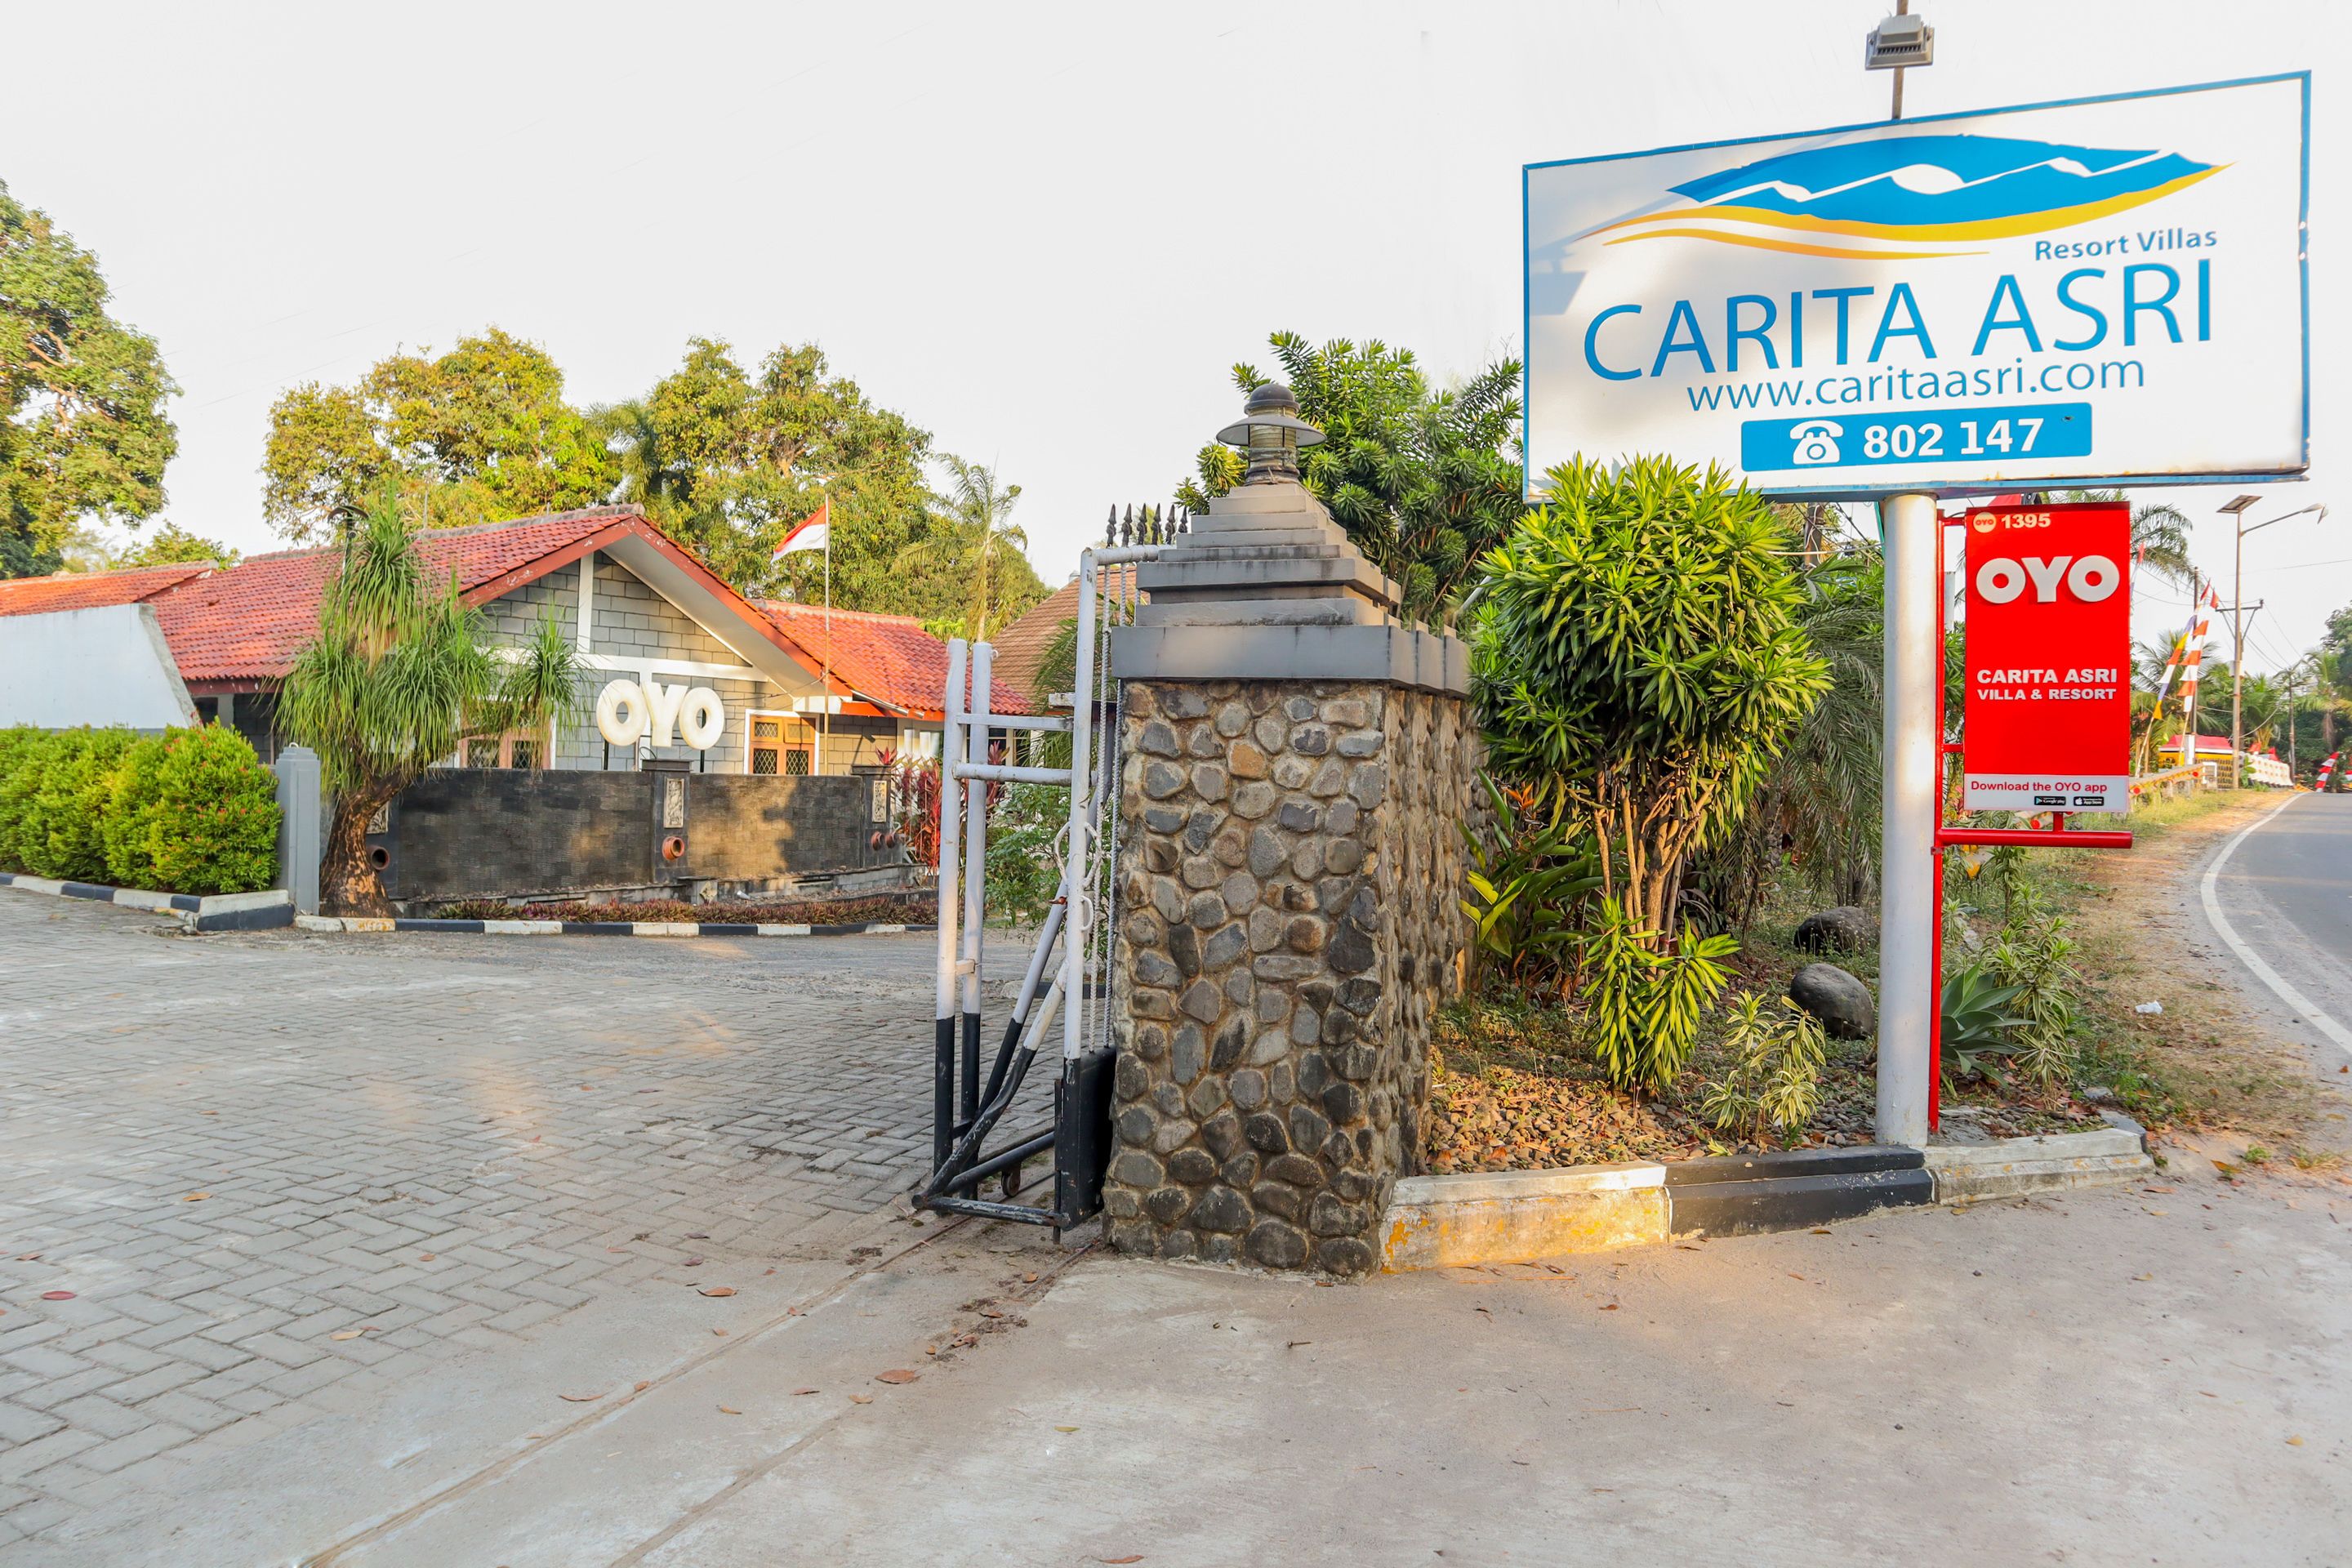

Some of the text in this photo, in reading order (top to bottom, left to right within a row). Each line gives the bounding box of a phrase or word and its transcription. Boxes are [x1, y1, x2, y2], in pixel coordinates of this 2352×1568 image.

[2035, 228, 2218, 261] Resort Villas
[1584, 258, 2212, 381] CARITA ASRI
[1687, 359, 2145, 412] www.caritaasri.com
[1863, 418, 2044, 458] 802 147
[2001, 513, 2051, 529] 1395
[1976, 555, 2121, 604] OYO
[1976, 668, 2118, 684] CARITA ASRI
[1977, 688, 2117, 701] VILLA & RESORT
[595, 679, 725, 749] OYO
[1971, 781, 2108, 794] Download the OYO app
